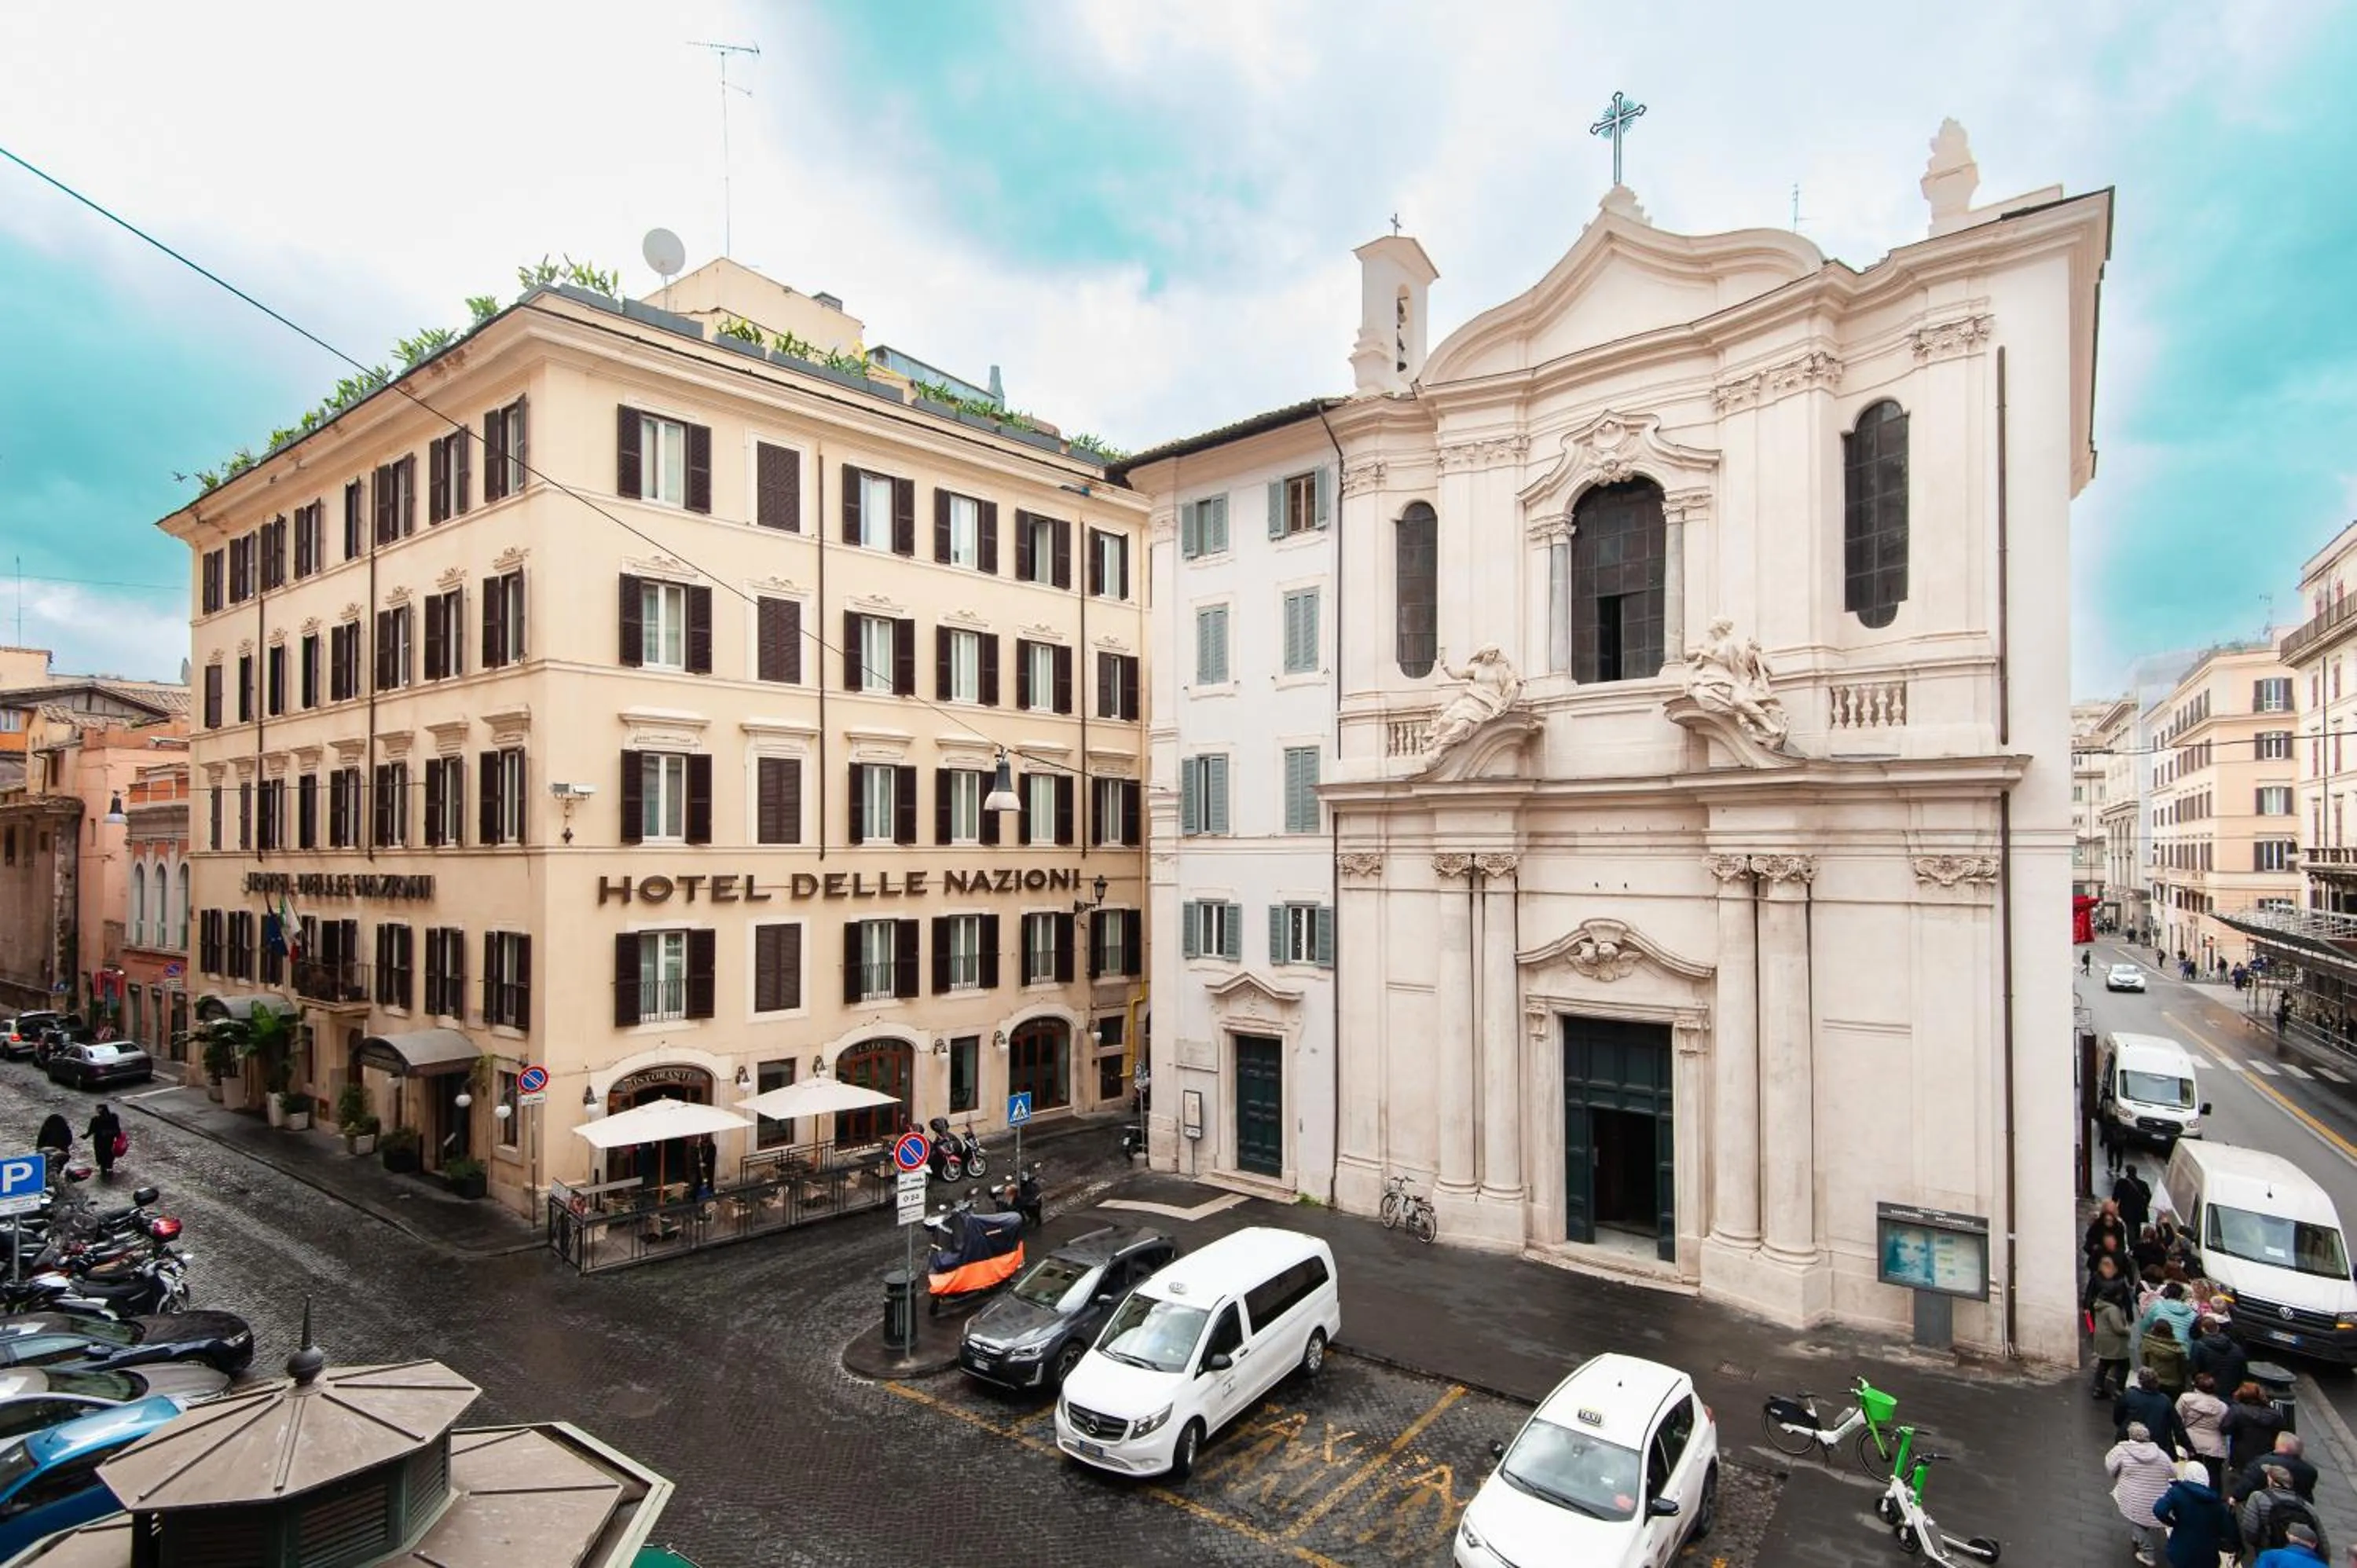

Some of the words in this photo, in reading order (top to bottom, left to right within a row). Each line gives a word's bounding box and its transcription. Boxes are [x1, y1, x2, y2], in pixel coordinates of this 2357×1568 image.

[598, 874, 772, 905] HOTEL
[790, 871, 928, 902] DELLE
[944, 867, 1082, 896] NAZIONI
[2, 1163, 33, 1192] P
